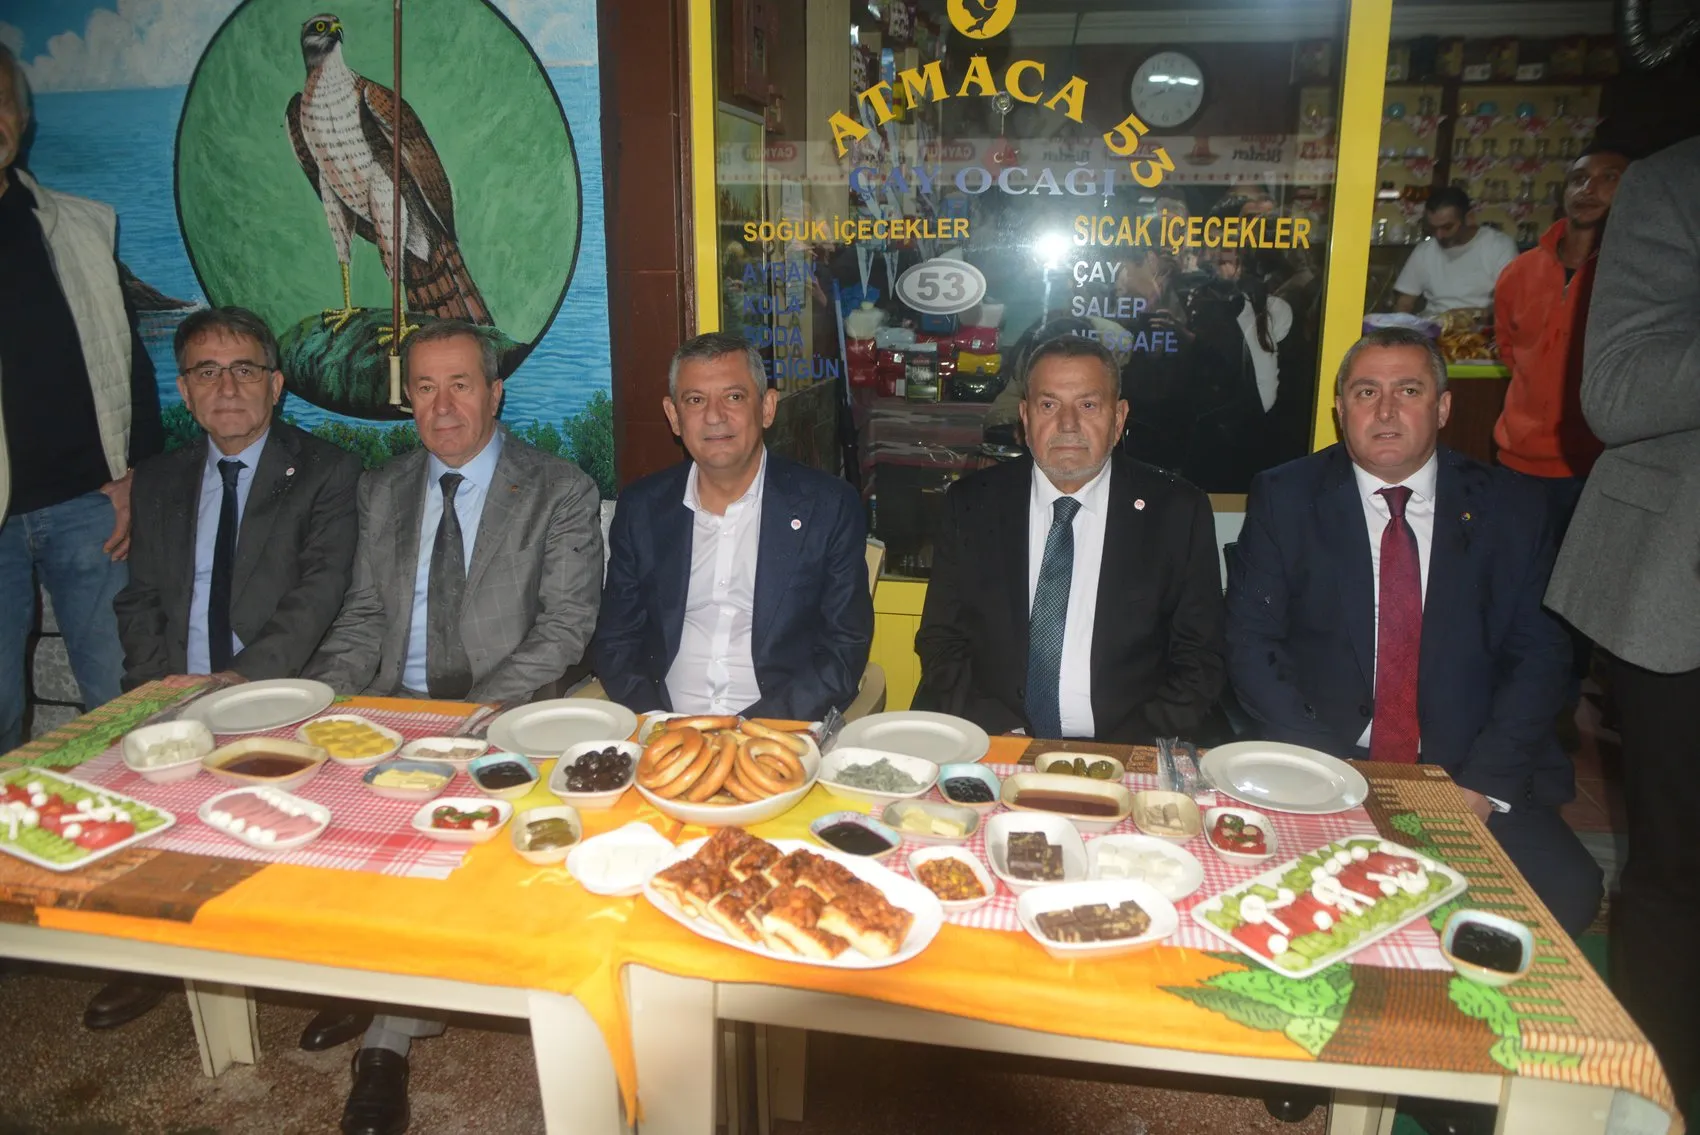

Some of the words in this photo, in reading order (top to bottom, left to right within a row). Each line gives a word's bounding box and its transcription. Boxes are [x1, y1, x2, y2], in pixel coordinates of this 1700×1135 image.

[828, 56, 1088, 158] ATMACA
[1103, 113, 1175, 188] 53
[955, 160, 1117, 198] OCAĞI
[743, 216, 827, 242] SOĞUK
[834, 215, 970, 245] İÇECEKLER
[1073, 214, 1152, 246] SICAK
[1160, 208, 1311, 255] İÇECEKLER
[742, 261, 817, 284] AYRAN
[916, 272, 966, 301] 53
[1073, 260, 1121, 287] ÇAY
[742, 295, 802, 316] KOLA
[1071, 296, 1147, 319] SALEP
[743, 325, 803, 347] SODA
